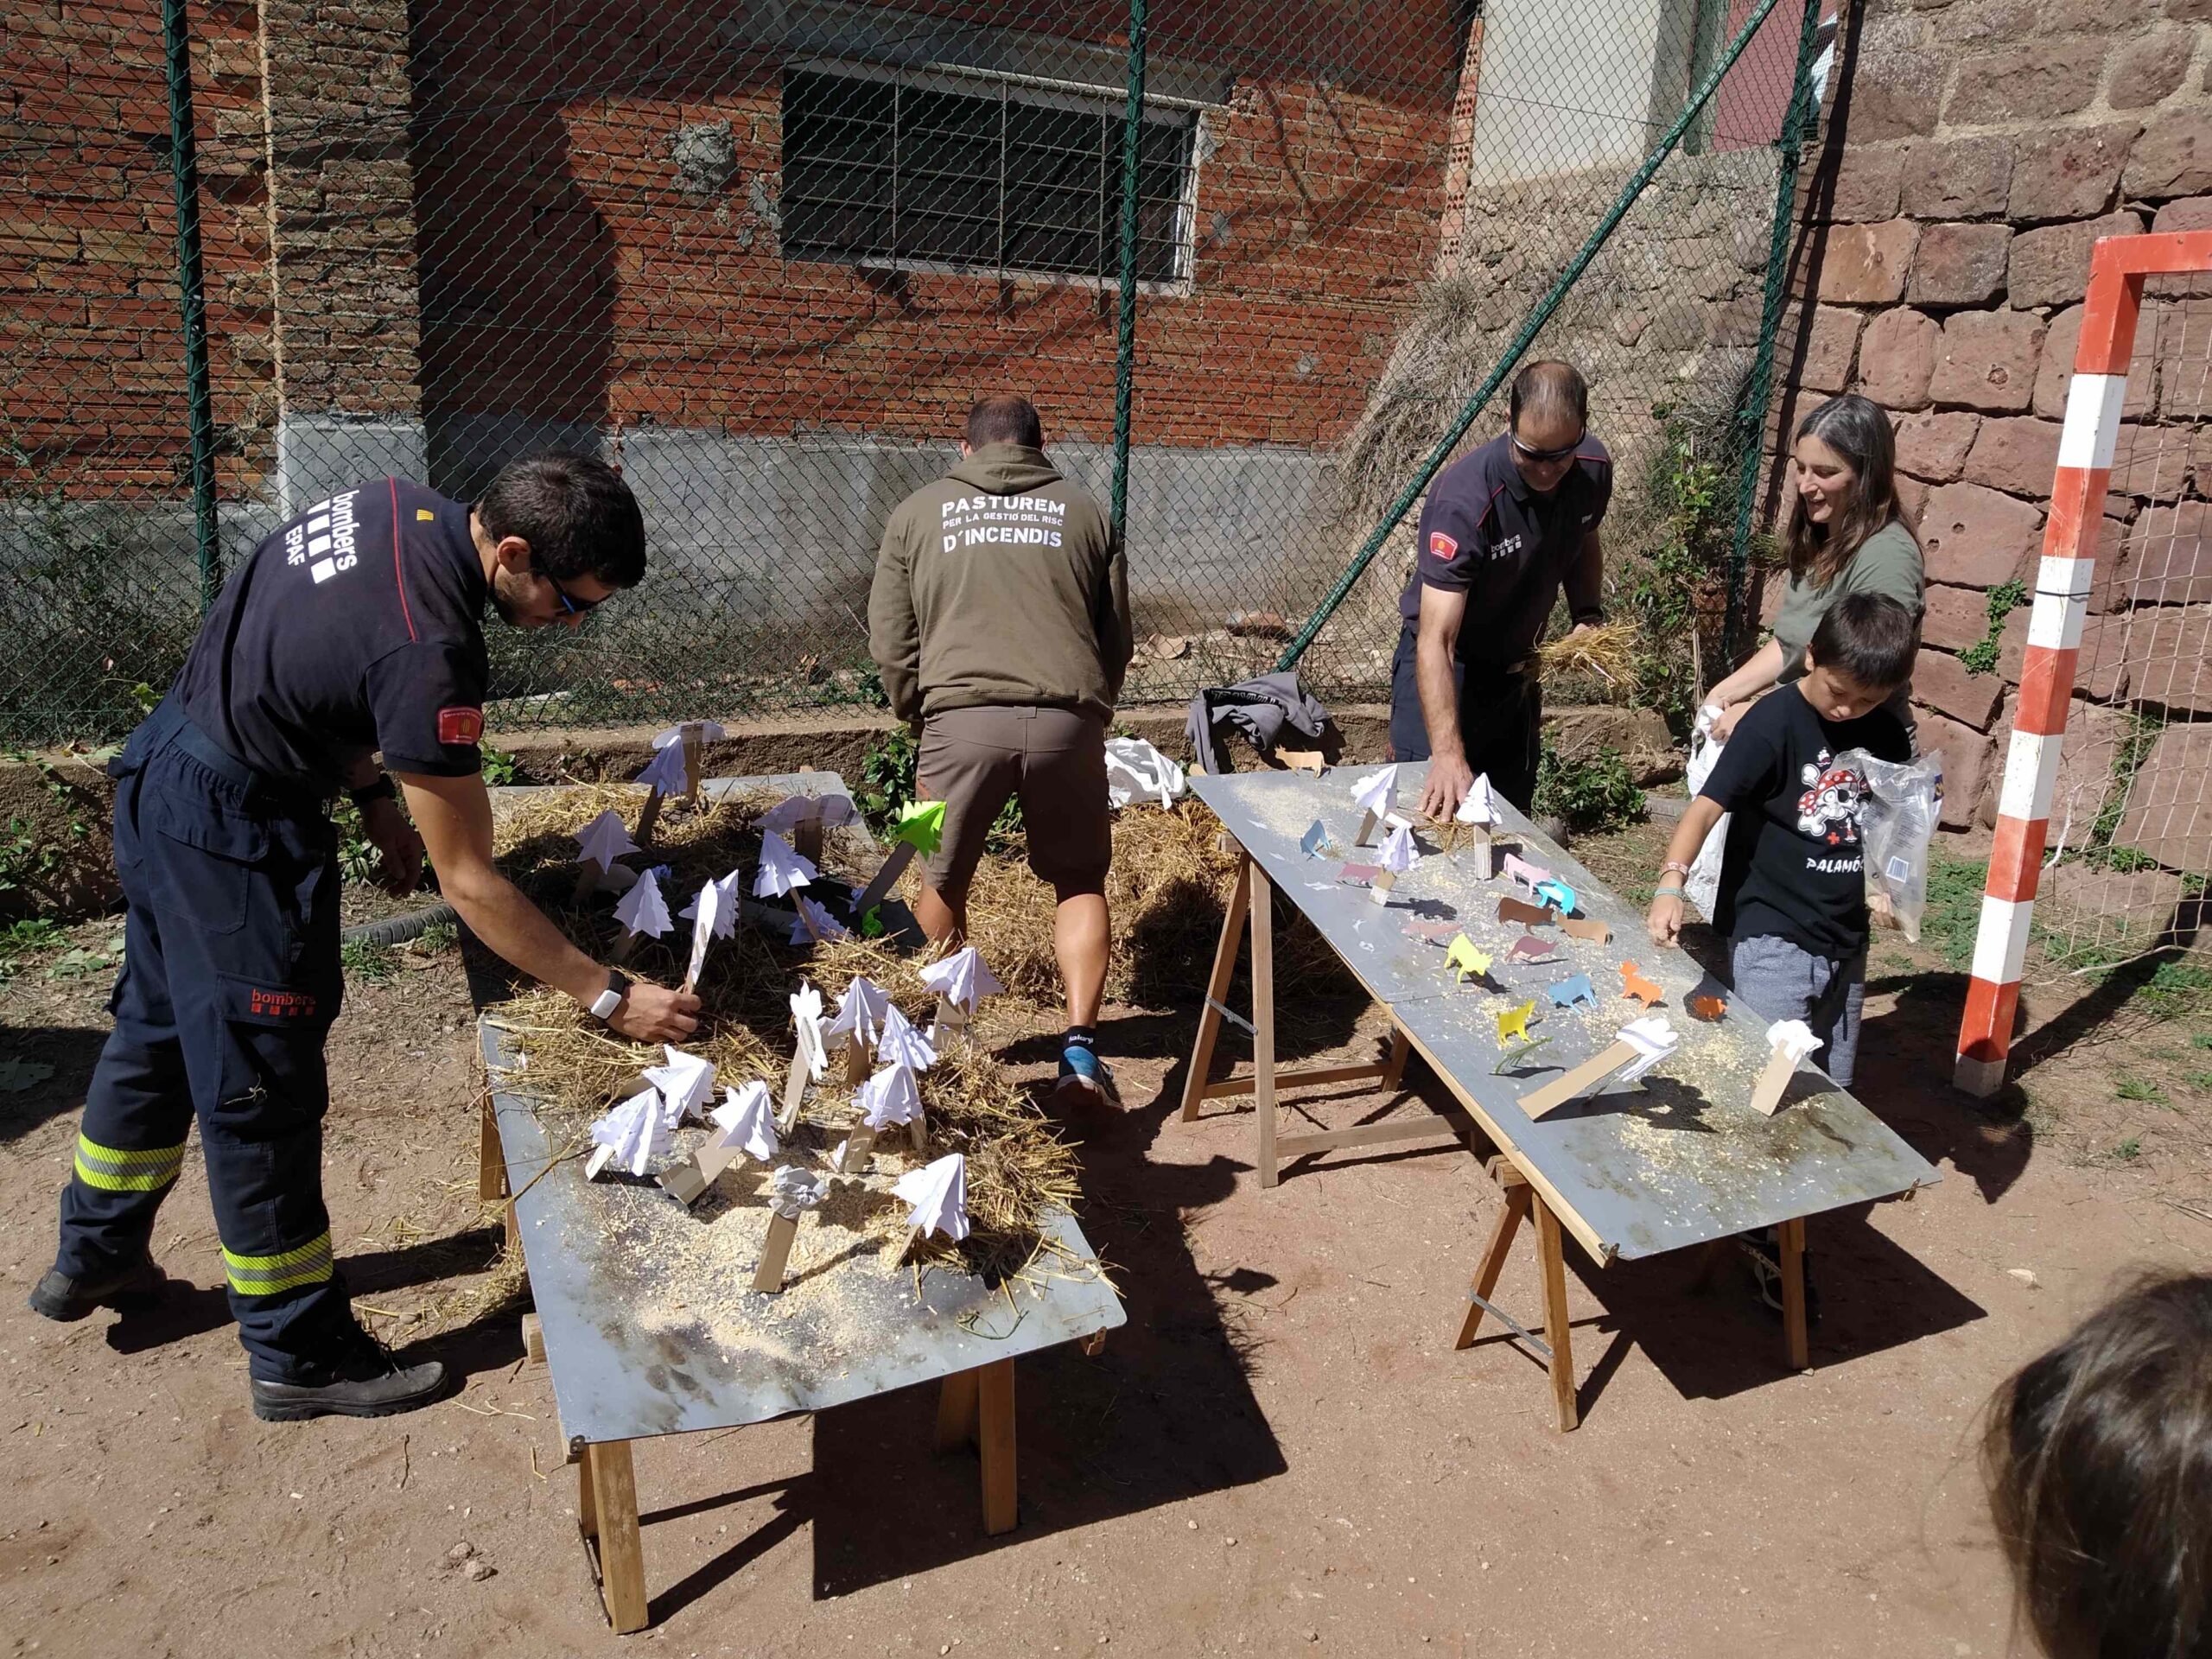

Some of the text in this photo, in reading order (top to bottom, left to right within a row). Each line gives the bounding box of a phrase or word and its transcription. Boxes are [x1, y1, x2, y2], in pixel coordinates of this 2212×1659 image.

[942, 496, 1066, 518] PASTUREM
[332, 490, 359, 570] bombers
[943, 518, 962, 530] PER
[965, 513, 980, 523] LA
[983, 512, 1019, 521] GESTIÓ
[1041, 515, 1063, 526] RISC
[286, 524, 305, 565] EPAF
[252, 988, 316, 1005] bombers
